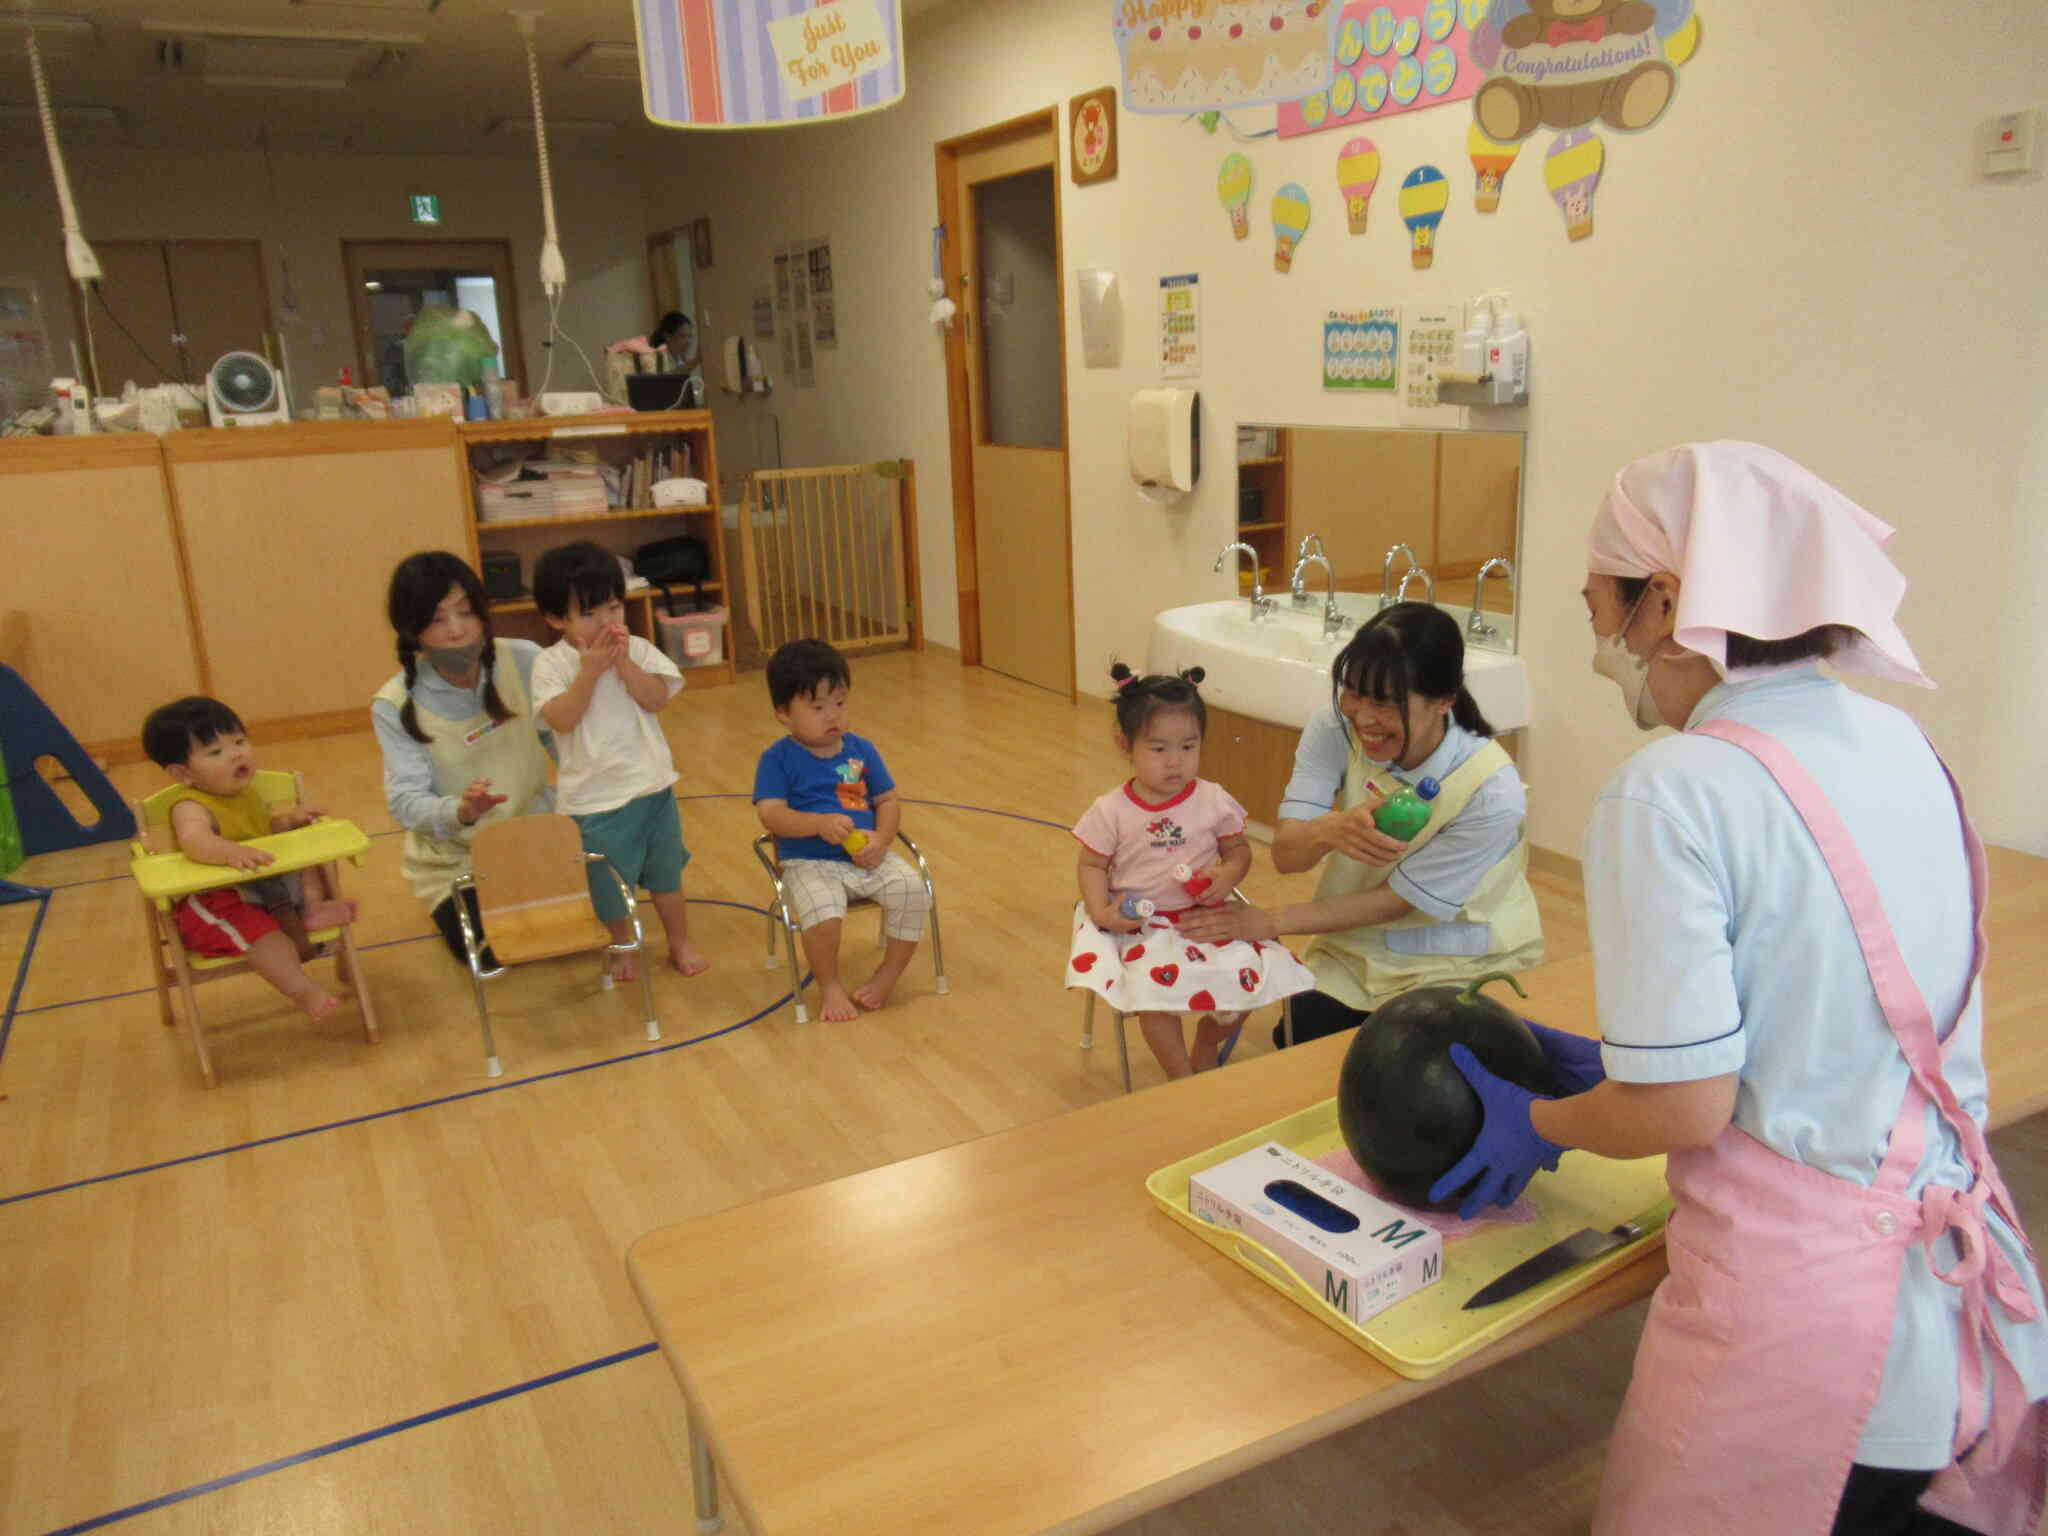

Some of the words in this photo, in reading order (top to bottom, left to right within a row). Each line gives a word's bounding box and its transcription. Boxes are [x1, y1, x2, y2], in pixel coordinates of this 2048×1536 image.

[803, 12, 847, 52] Just
[788, 58, 830, 86] For
[832, 38, 881, 73] You
[1503, 33, 1653, 81] Congratulations!
[1370, 1219, 1427, 1249] M
[1422, 1252, 1438, 1283] M
[1326, 1269, 1349, 1313] M
